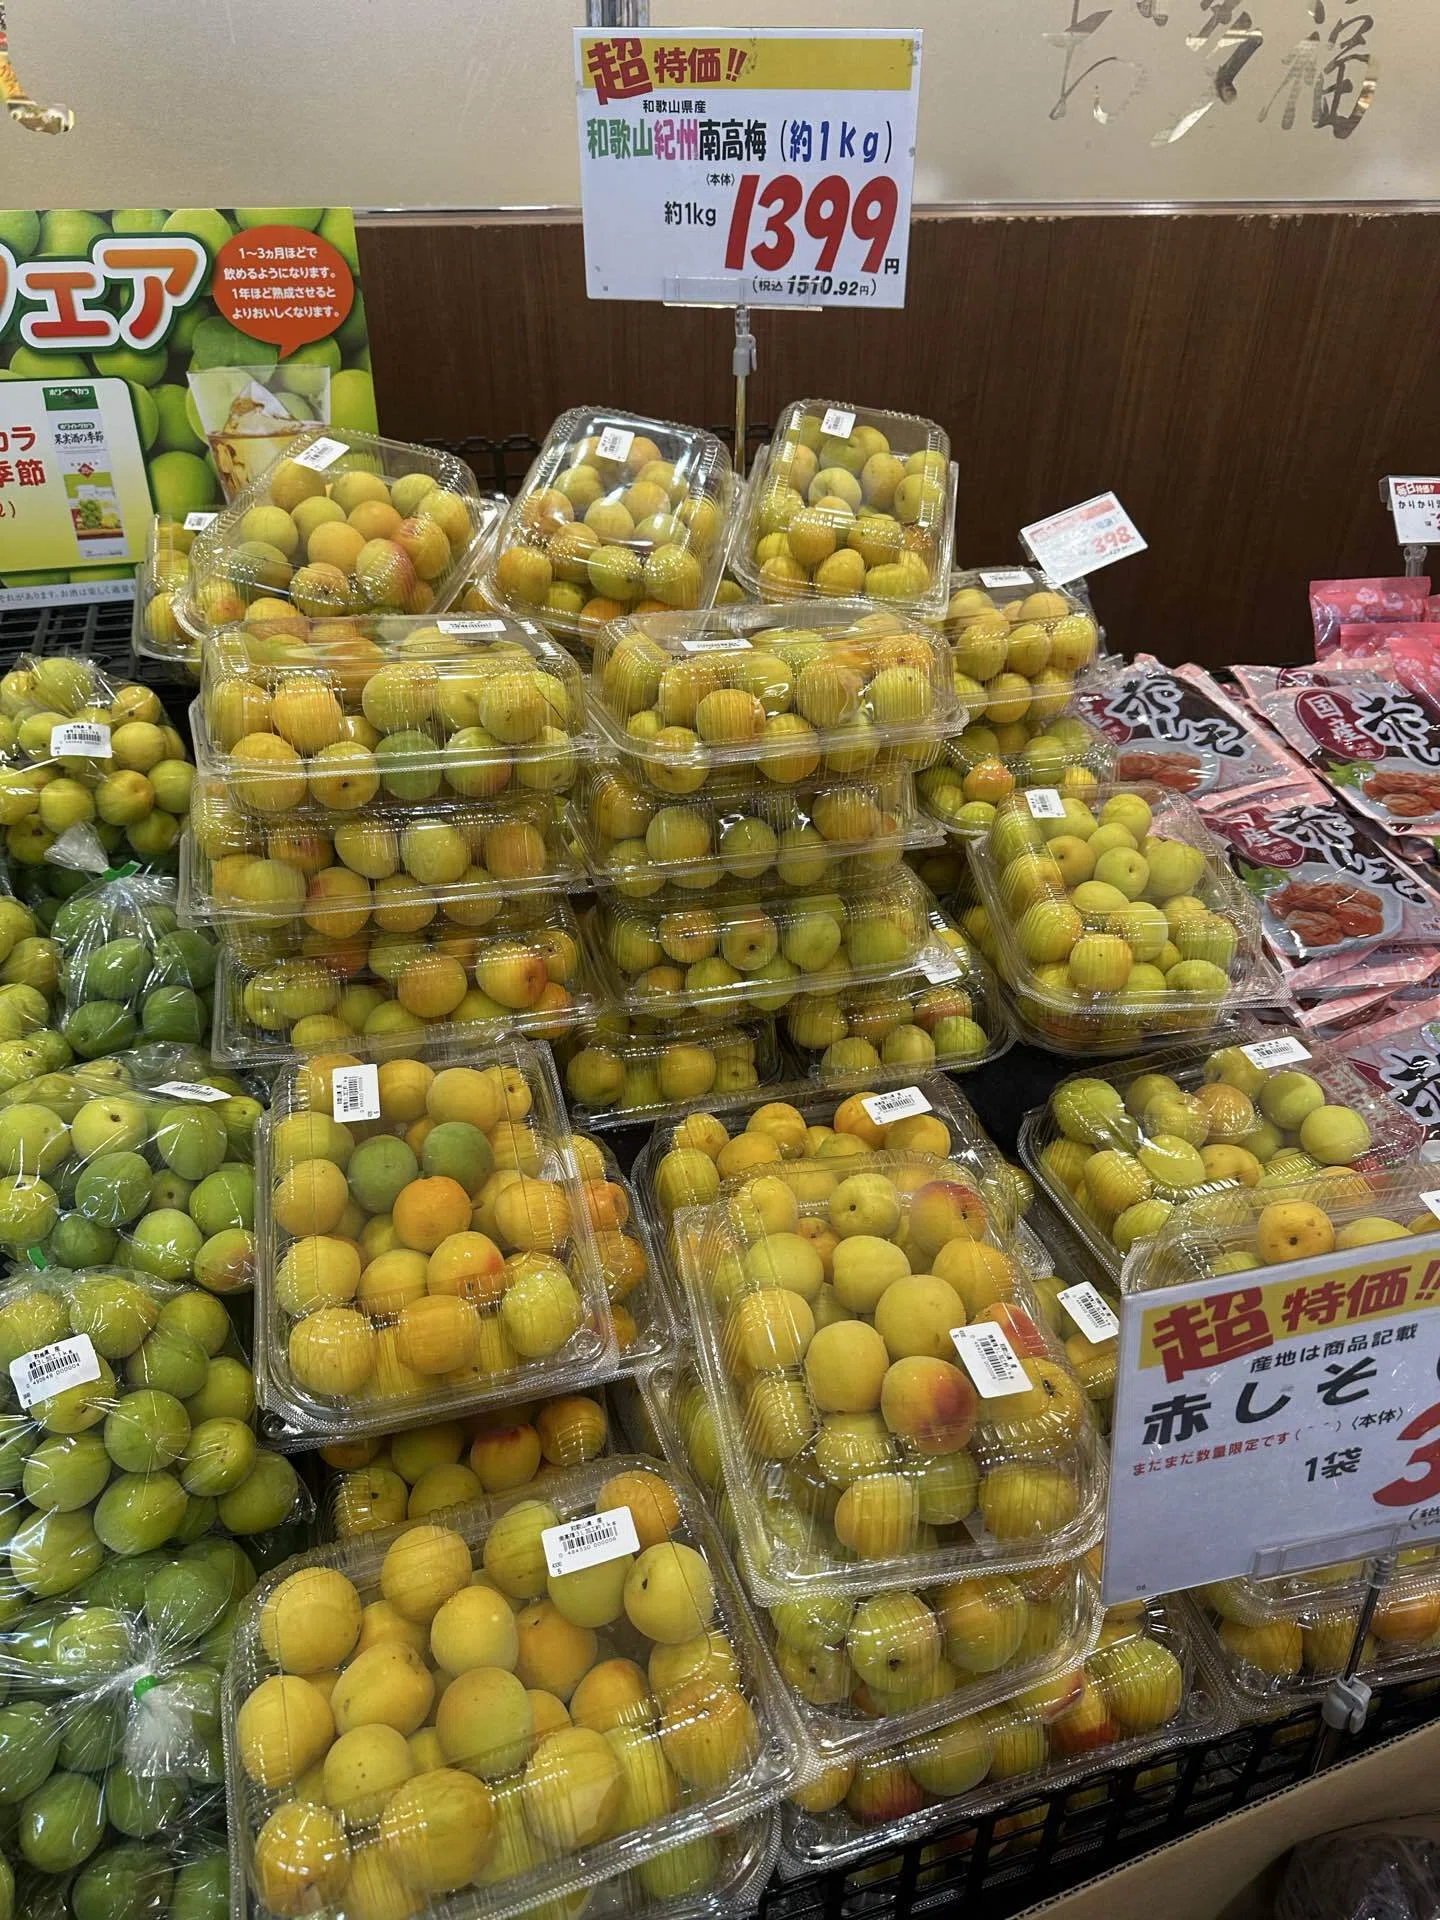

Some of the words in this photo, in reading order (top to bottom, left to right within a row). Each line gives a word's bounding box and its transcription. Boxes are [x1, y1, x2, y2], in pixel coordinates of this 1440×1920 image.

[643, 100, 707, 114] 和歌山県産
[586, 118, 767, 161] 和歌山紀州南高梅
[664, 201, 717, 227] 約1kg
[223, 266, 337, 281] 飲めるようになります。
[0, 248, 198, 339] ェア
[231, 286, 337, 300] 1年ほど熟成させると
[232, 305, 340, 320] よりおいしくなります。
[54, 429, 105, 445] 果実酒の季節
[1250, 1323, 1419, 1373] 産地は商品記載
[1304, 1447, 1363, 1482] 1袋
